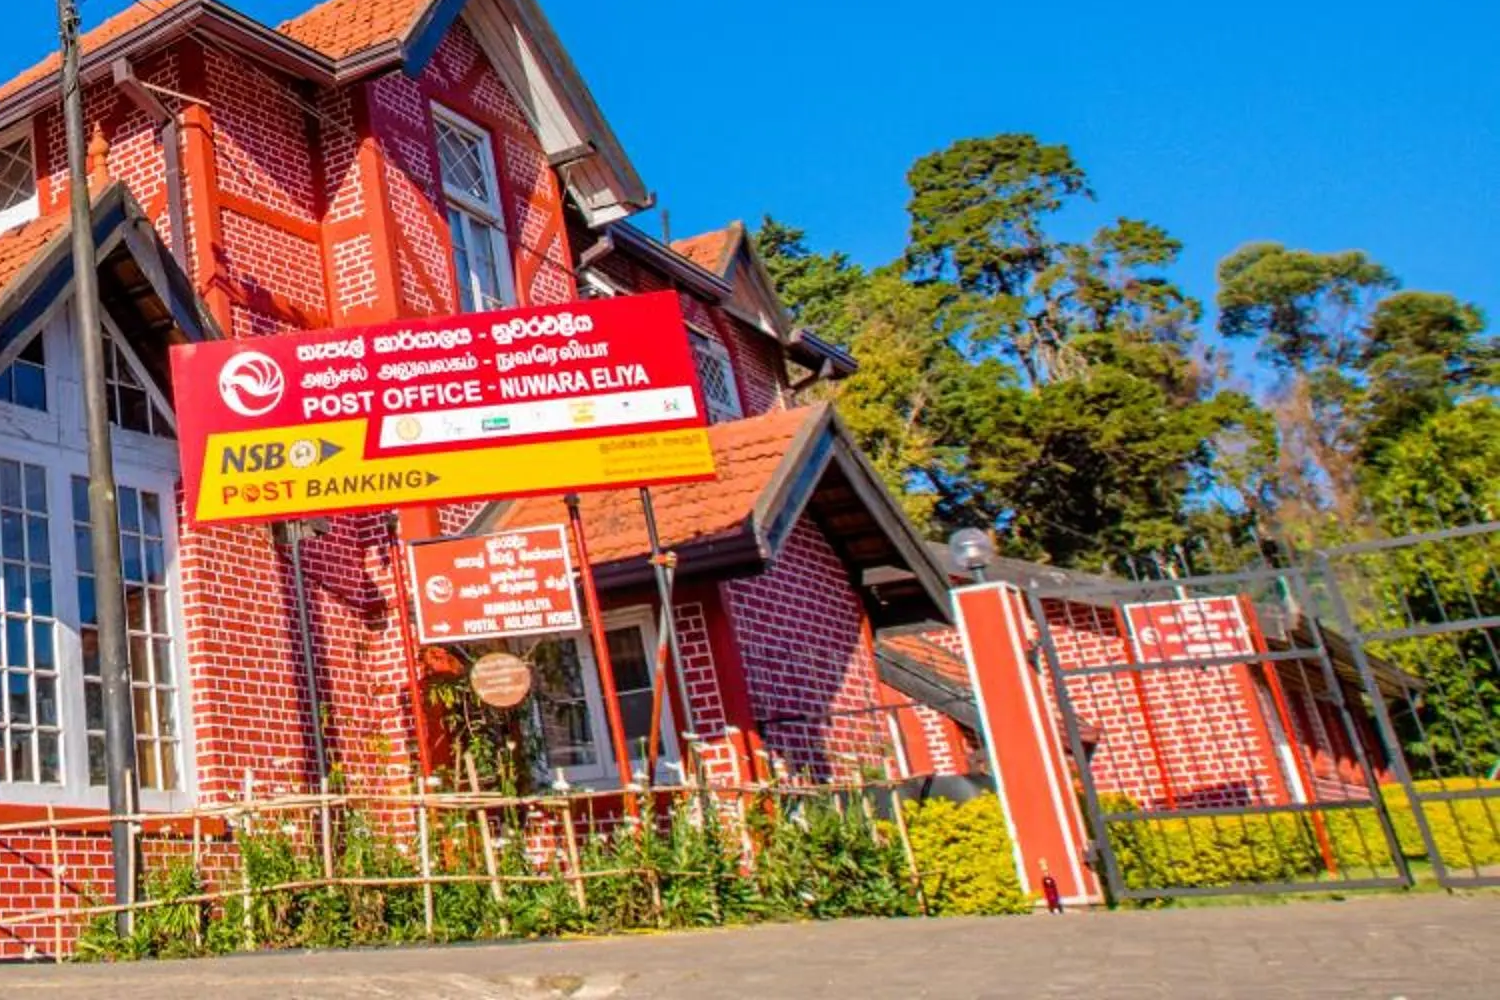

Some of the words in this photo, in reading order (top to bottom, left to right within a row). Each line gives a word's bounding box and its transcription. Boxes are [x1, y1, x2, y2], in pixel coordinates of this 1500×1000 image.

[301, 362, 368, 389] அஞ்சல்
[377, 352, 479, 381] அலுவலகம்
[302, 390, 375, 419] POST
[383, 380, 483, 410] OFFICE
[500, 370, 589, 399] NUWARA
[591, 363, 650, 389] ELIYA
[221, 442, 285, 474] NSB
[222, 480, 296, 505] POST
[306, 470, 422, 498] BANKING
